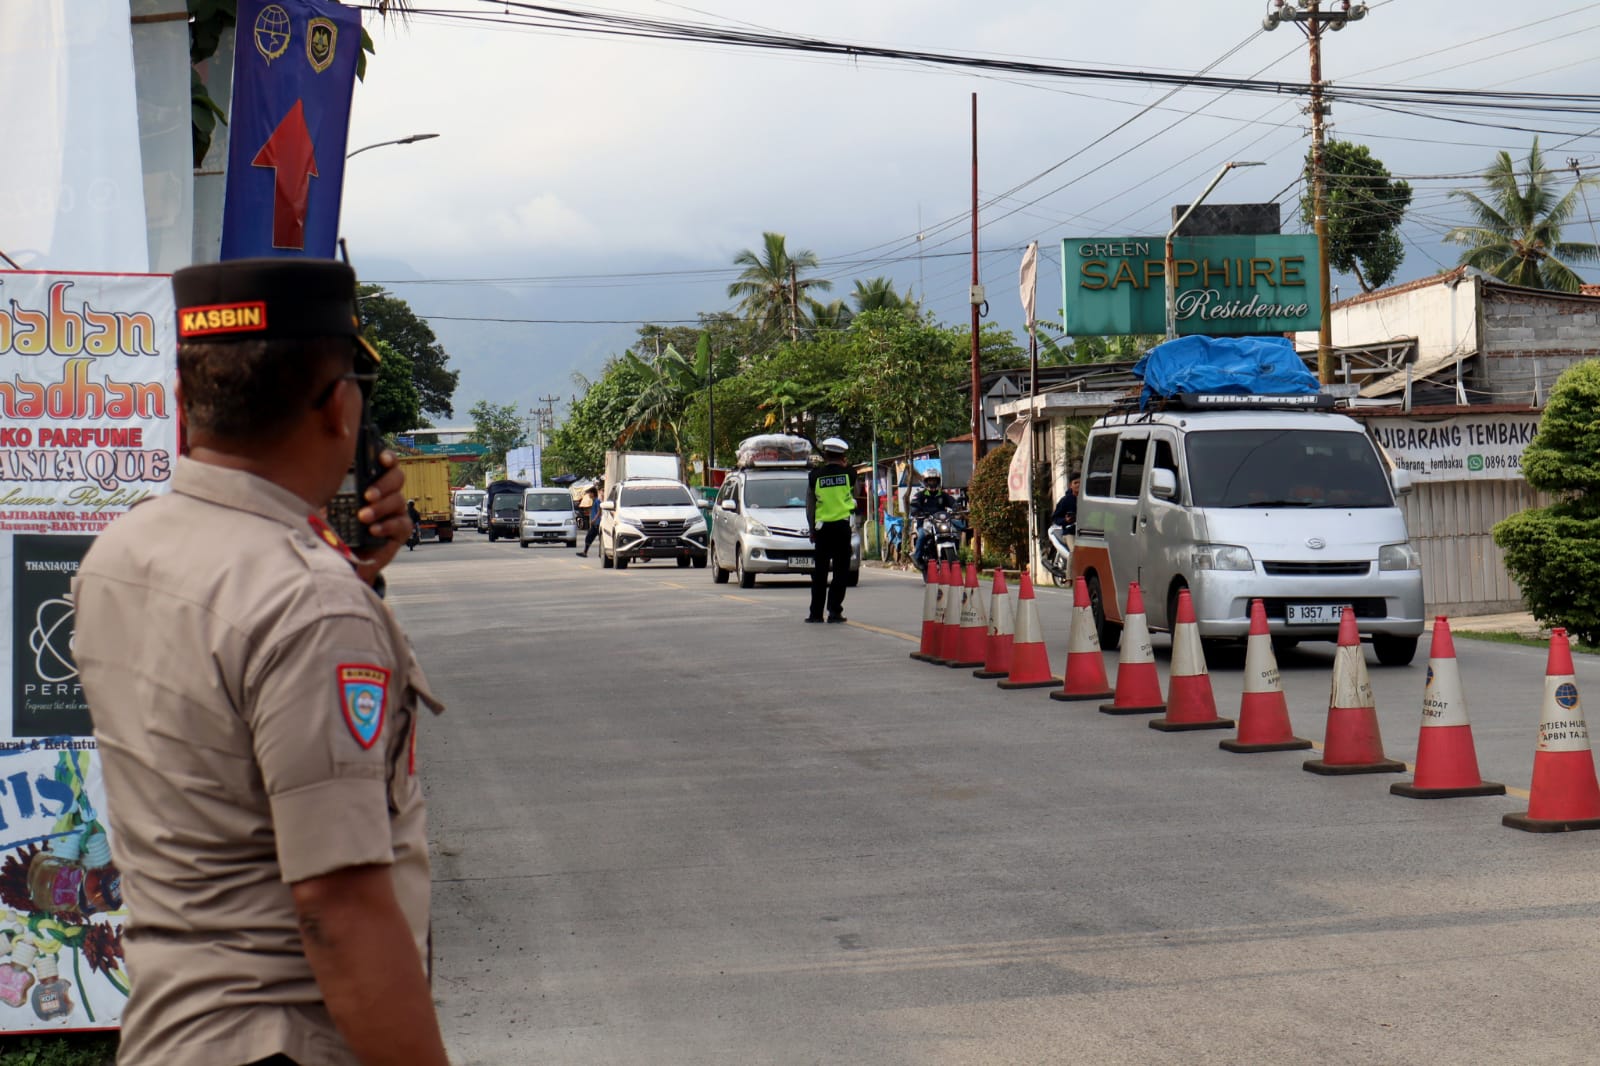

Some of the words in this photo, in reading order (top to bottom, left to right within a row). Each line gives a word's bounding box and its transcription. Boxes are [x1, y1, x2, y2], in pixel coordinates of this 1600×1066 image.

[1079, 242, 1149, 257] GREEN
[1080, 256, 1306, 290] SAPPHIRE
[1174, 289, 1310, 320] Residence
[182, 307, 261, 331] KASBIN
[38, 428, 142, 447] PARFUME
[1485, 455, 1506, 470] 0896
[820, 476, 845, 487] POLISI
[0, 510, 120, 522] AJIBARANG-BANY
[25, 560, 79, 574] THANIAQUE
[1288, 607, 1295, 618] B
[1301, 606, 1323, 618] 1357
[45, 738, 97, 750] Ketentu
